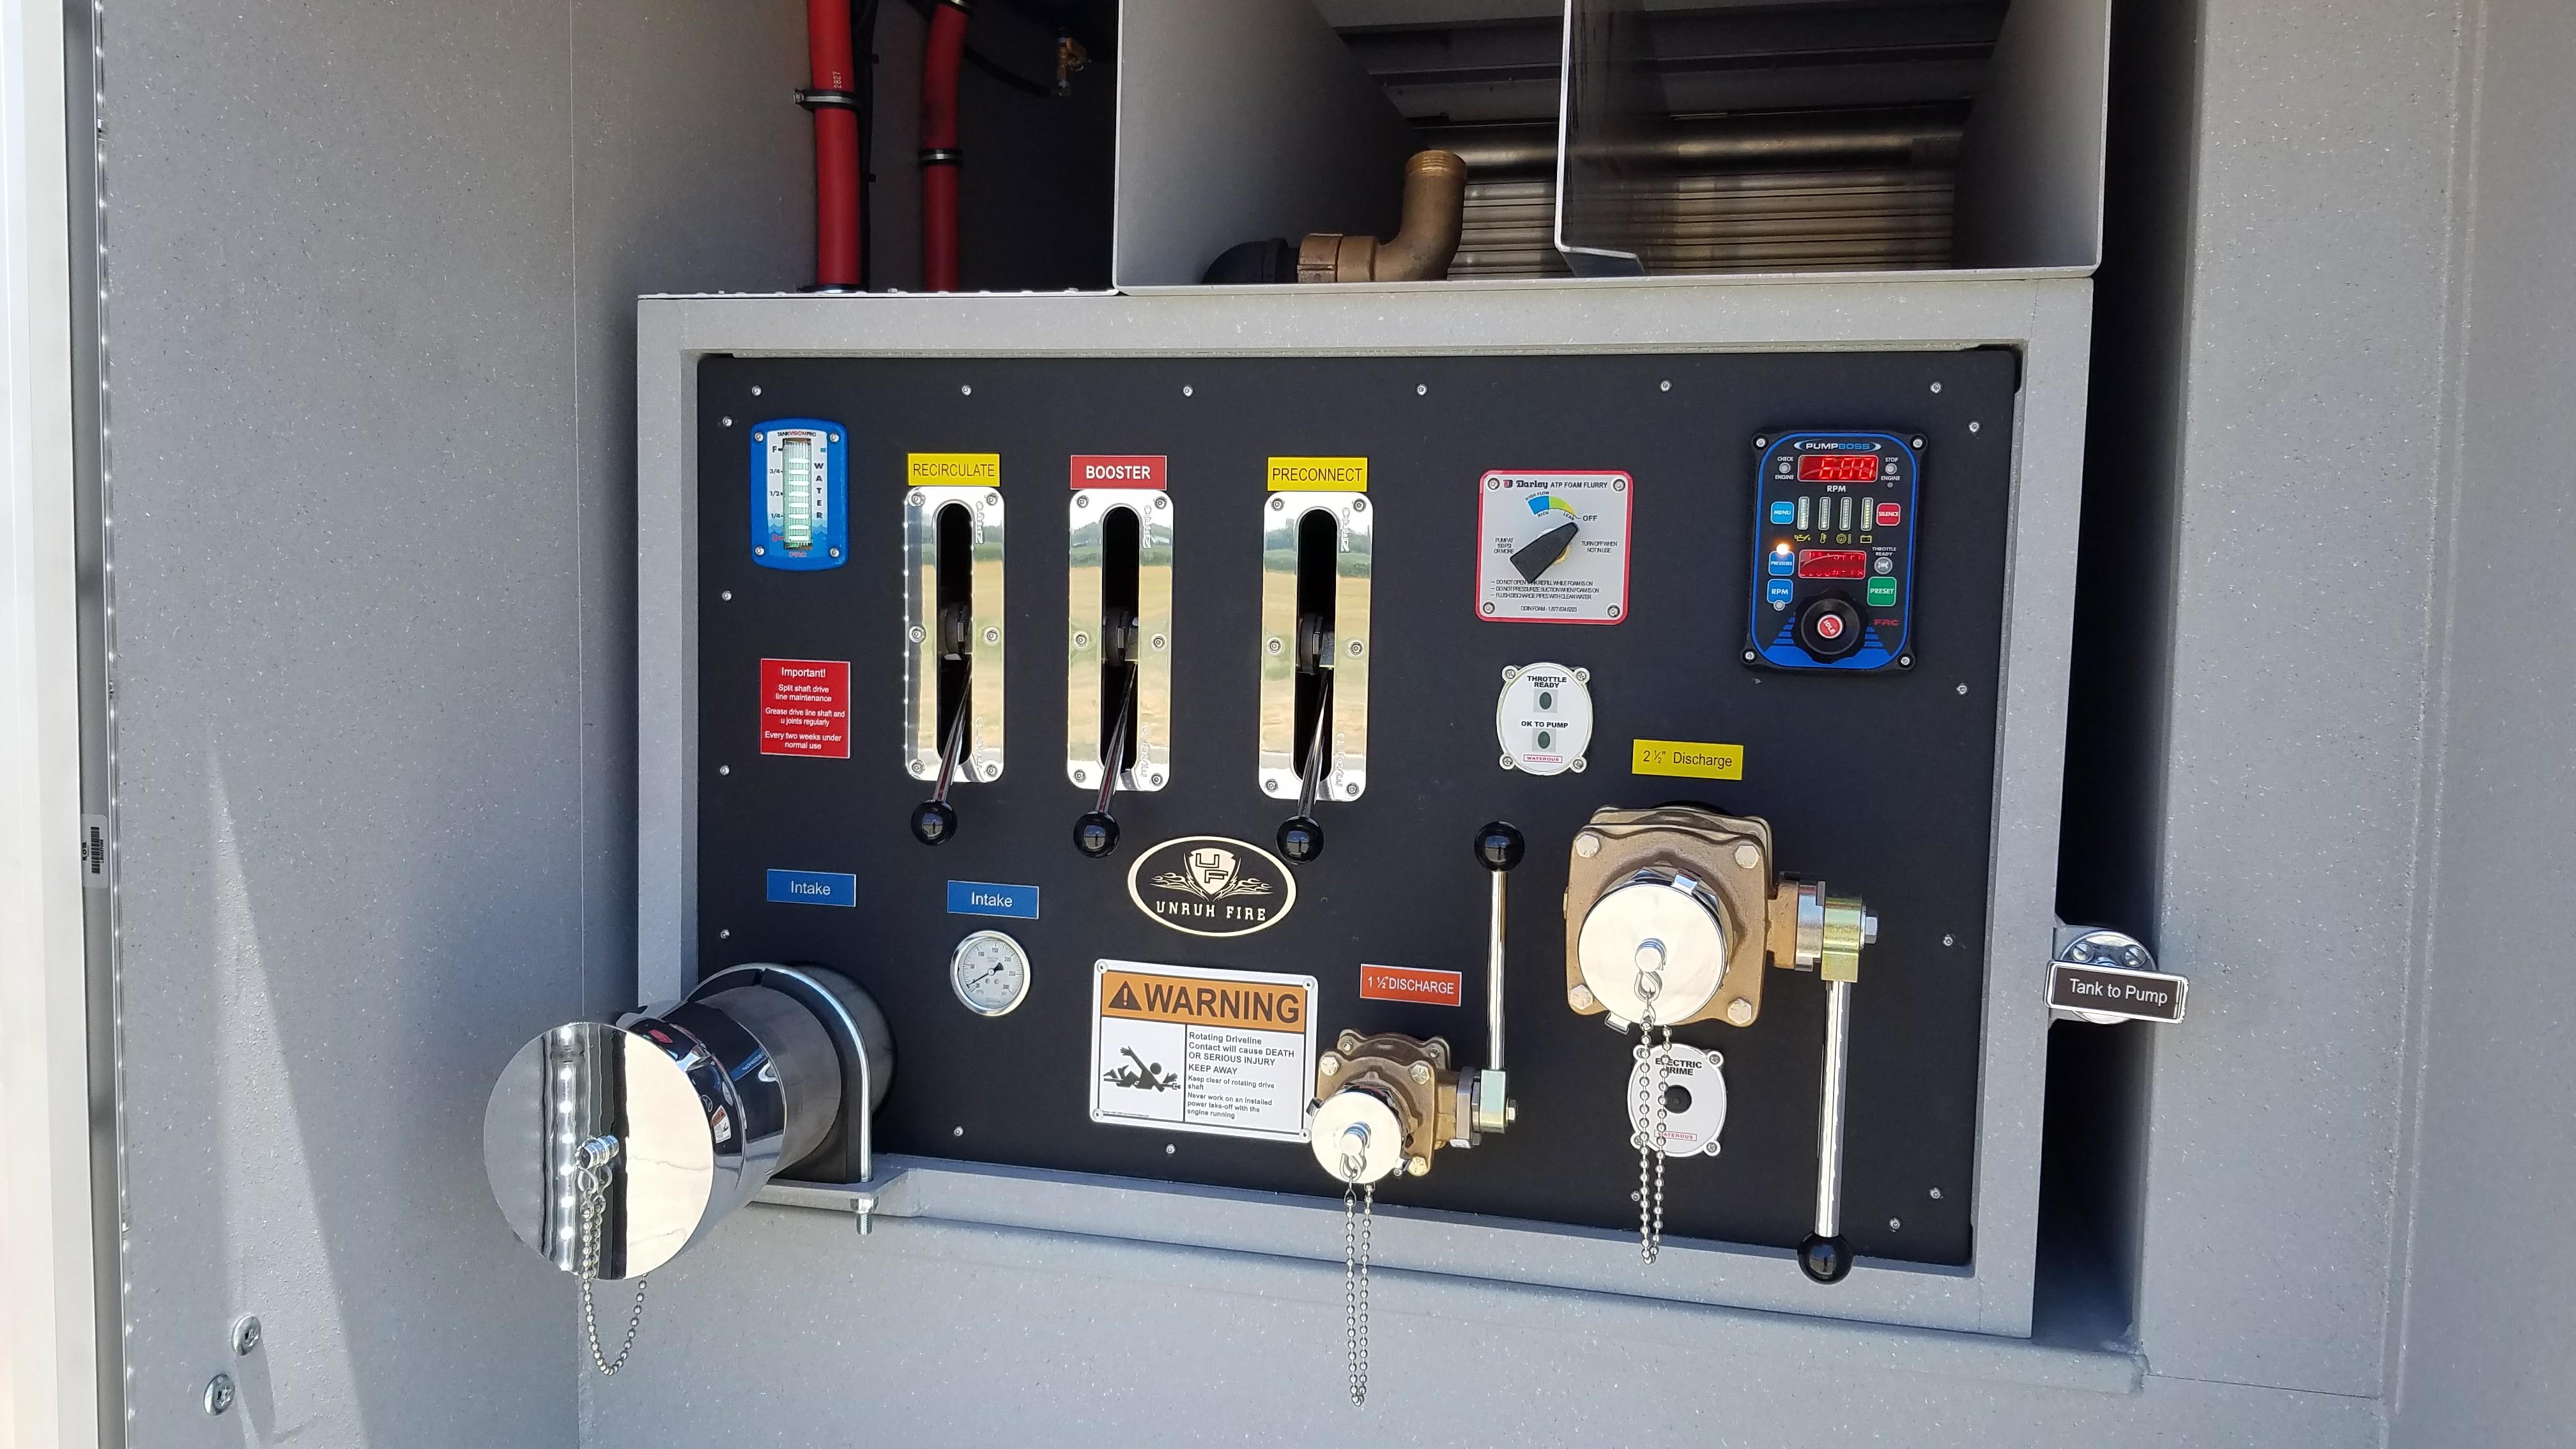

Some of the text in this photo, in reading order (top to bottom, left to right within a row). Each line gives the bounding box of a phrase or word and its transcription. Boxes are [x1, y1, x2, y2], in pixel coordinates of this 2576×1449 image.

[832, 71, 842, 89] 2827
[913, 463, 995, 477] RECIRCULATE
[1085, 465, 1151, 480] BOOSTER
[1272, 468, 1363, 482] PRECONNECT
[814, 463, 824, 519] WATER
[1516, 480, 1548, 489] Darley
[1563, 512, 1575, 521] LEAN
[1823, 620, 1836, 634] IDLE
[781, 667, 826, 678] Important!
[778, 684, 793, 693] Split
[789, 694, 832, 702] maintenance
[786, 717, 802, 726] joints
[804, 719, 830, 727] regularly
[765, 730, 785, 740] Every
[1643, 750, 1650, 762] 2
[1673, 751, 1733, 769] Discharge
[791, 880, 831, 895] Intake
[971, 892, 1013, 908] Intake
[1156, 901, 1266, 921] UNRUH FIRE
[1368, 976, 1372, 987] 1
[2069, 978, 2168, 1007] Tank to Pump
[1144, 982, 1300, 1023] WARNING
[1189, 1032, 1262, 1045] Rotating Driveline
[1189, 1042, 1220, 1052] Contact
[1266, 1048, 1294, 1057] DEATH
[1204, 1053, 1242, 1063] SERIOUS
[1244, 1056, 1276, 1066] INJURY
[1655, 1057, 1702, 1068] EECTRIC
[1188, 1064, 1238, 1075] KEEP AWAY
[1188, 1075, 1204, 1083] Keep
[1245, 1097, 1272, 1105] installed
[1210, 1111, 1235, 1119] running
